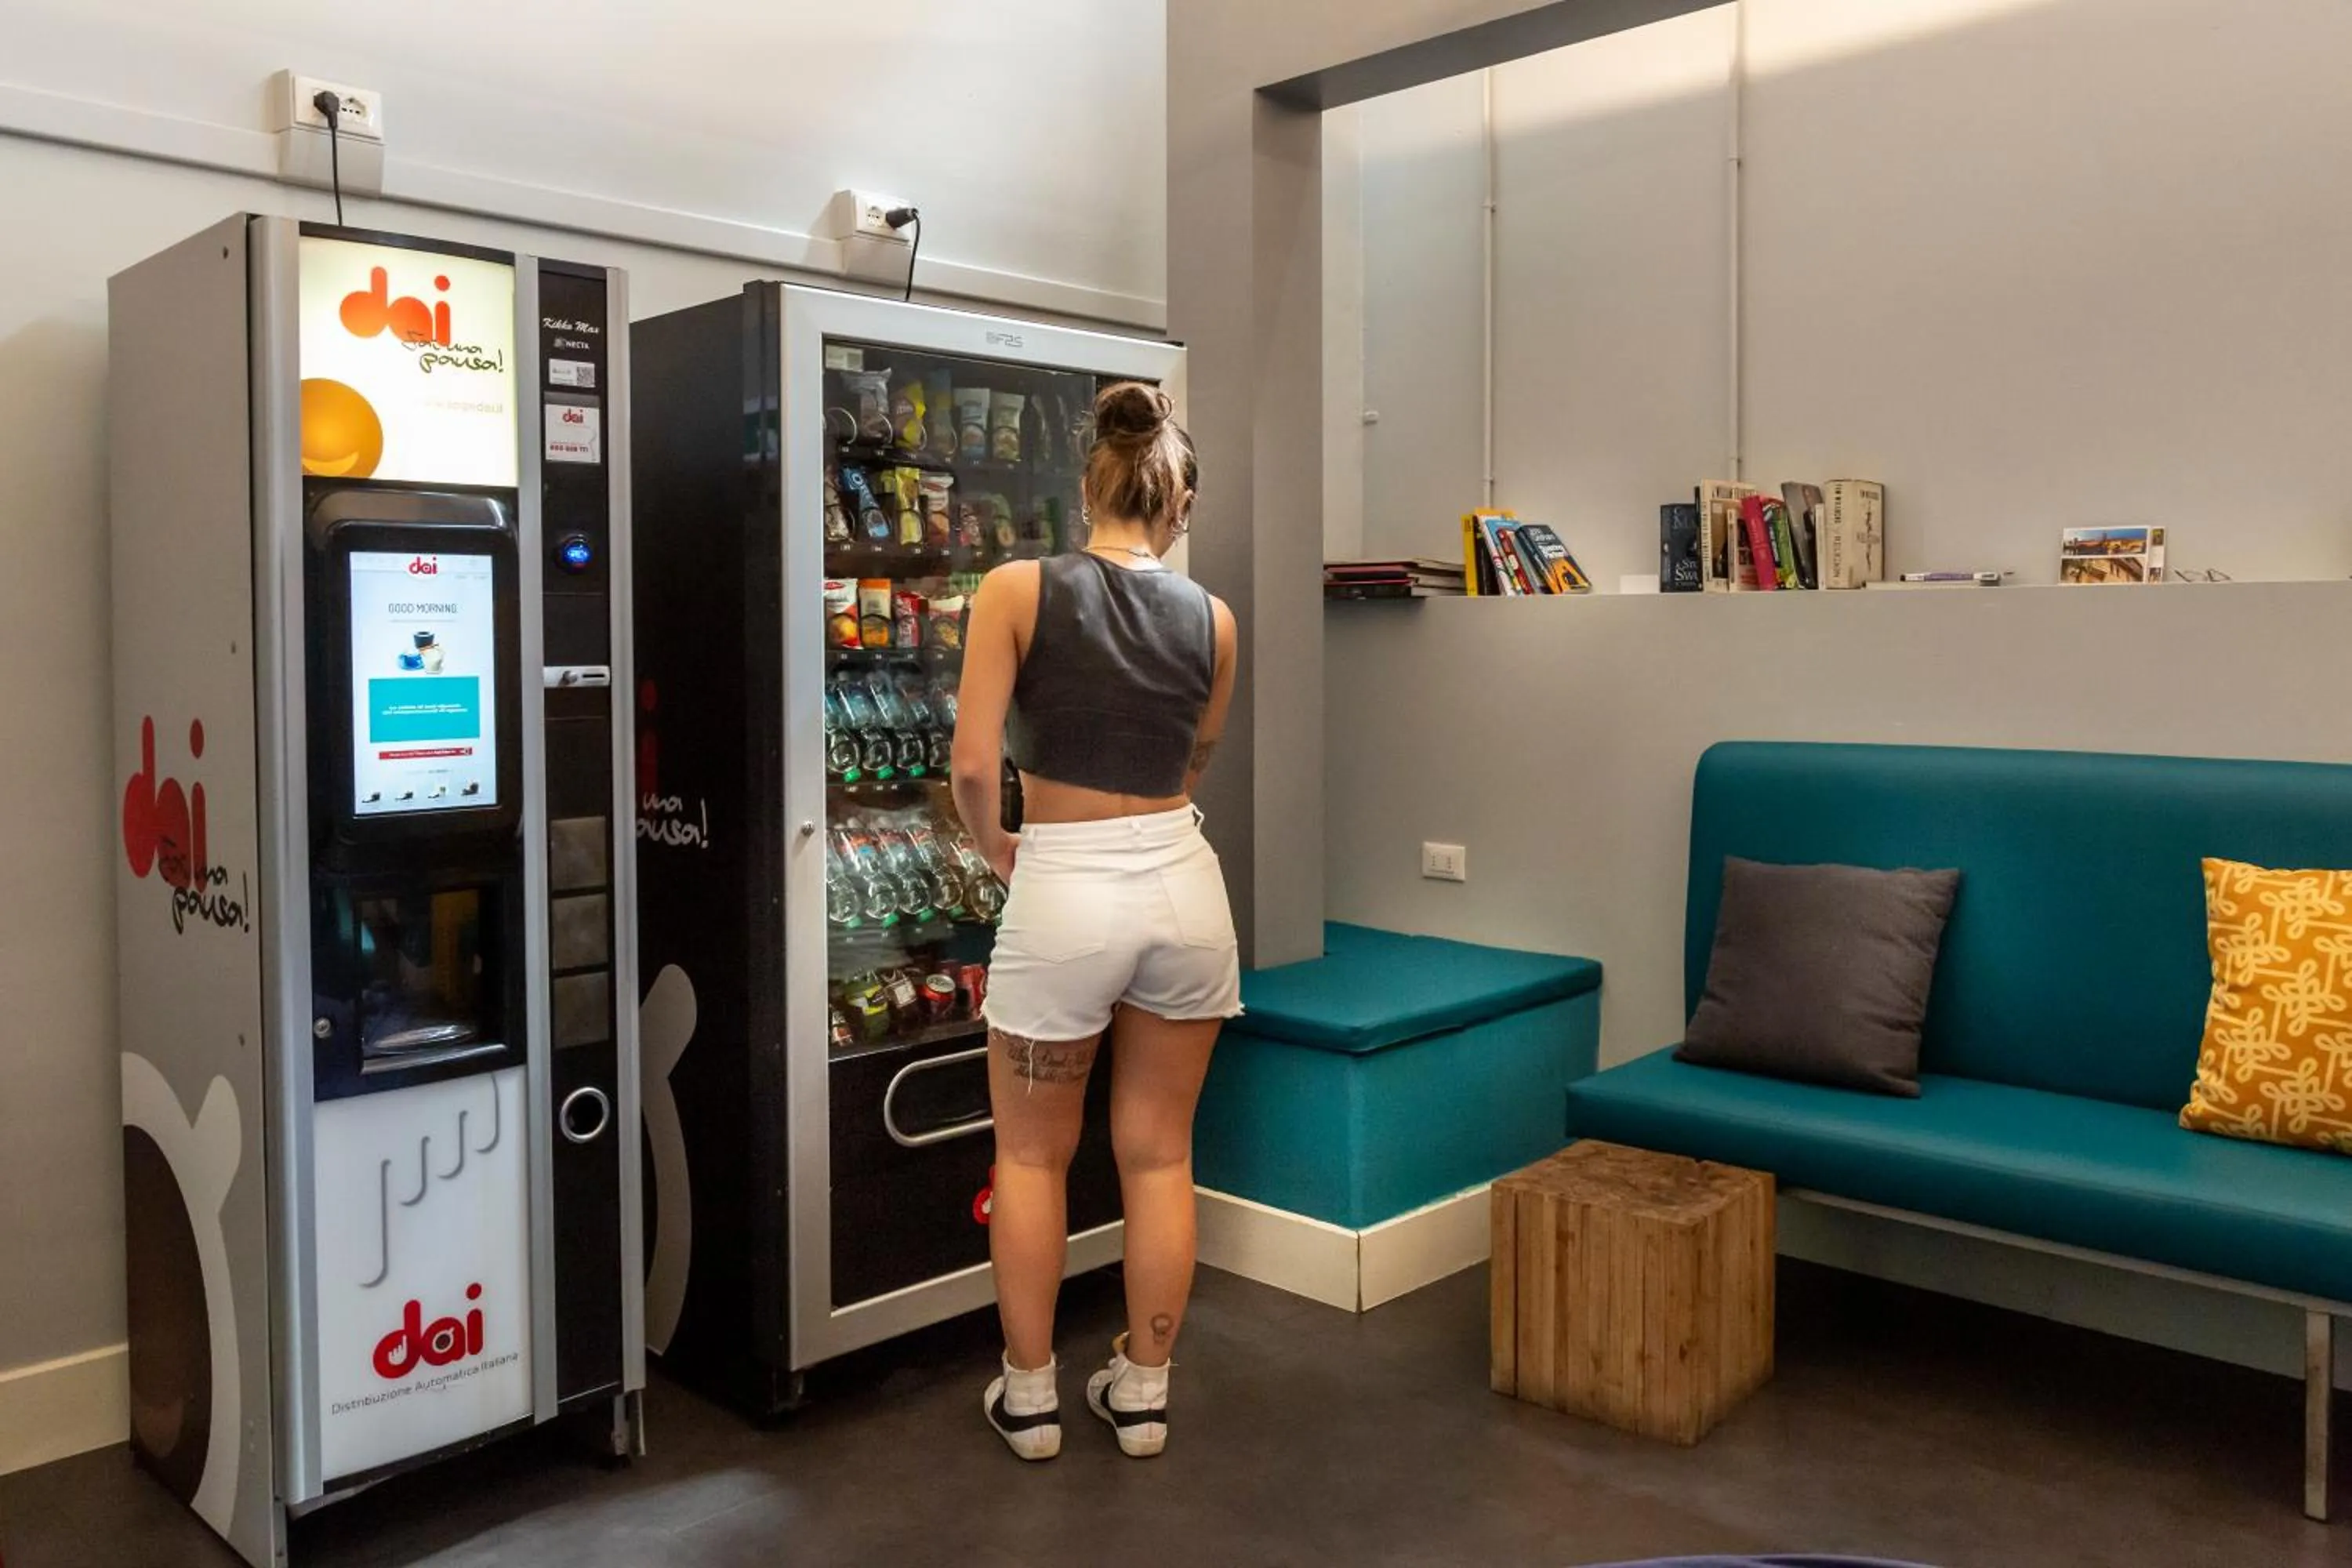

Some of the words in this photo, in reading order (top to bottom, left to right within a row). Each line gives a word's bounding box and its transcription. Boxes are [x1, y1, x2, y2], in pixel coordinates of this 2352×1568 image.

[339, 266, 451, 347] dai
[419, 348, 504, 374] pausa!
[562, 409, 584, 424] dai
[408, 557, 438, 574] dai
[388, 603, 414, 614] GOOD
[416, 604, 458, 615] MORNING
[123, 715, 207, 892] dai
[637, 797, 709, 849] ausa!
[172, 871, 250, 935] pausa!
[373, 1283, 483, 1379] dai
[332, 1385, 412, 1415] Distribuzione
[415, 1367, 480, 1392] Automatica
[481, 1352, 519, 1372] Italiana
